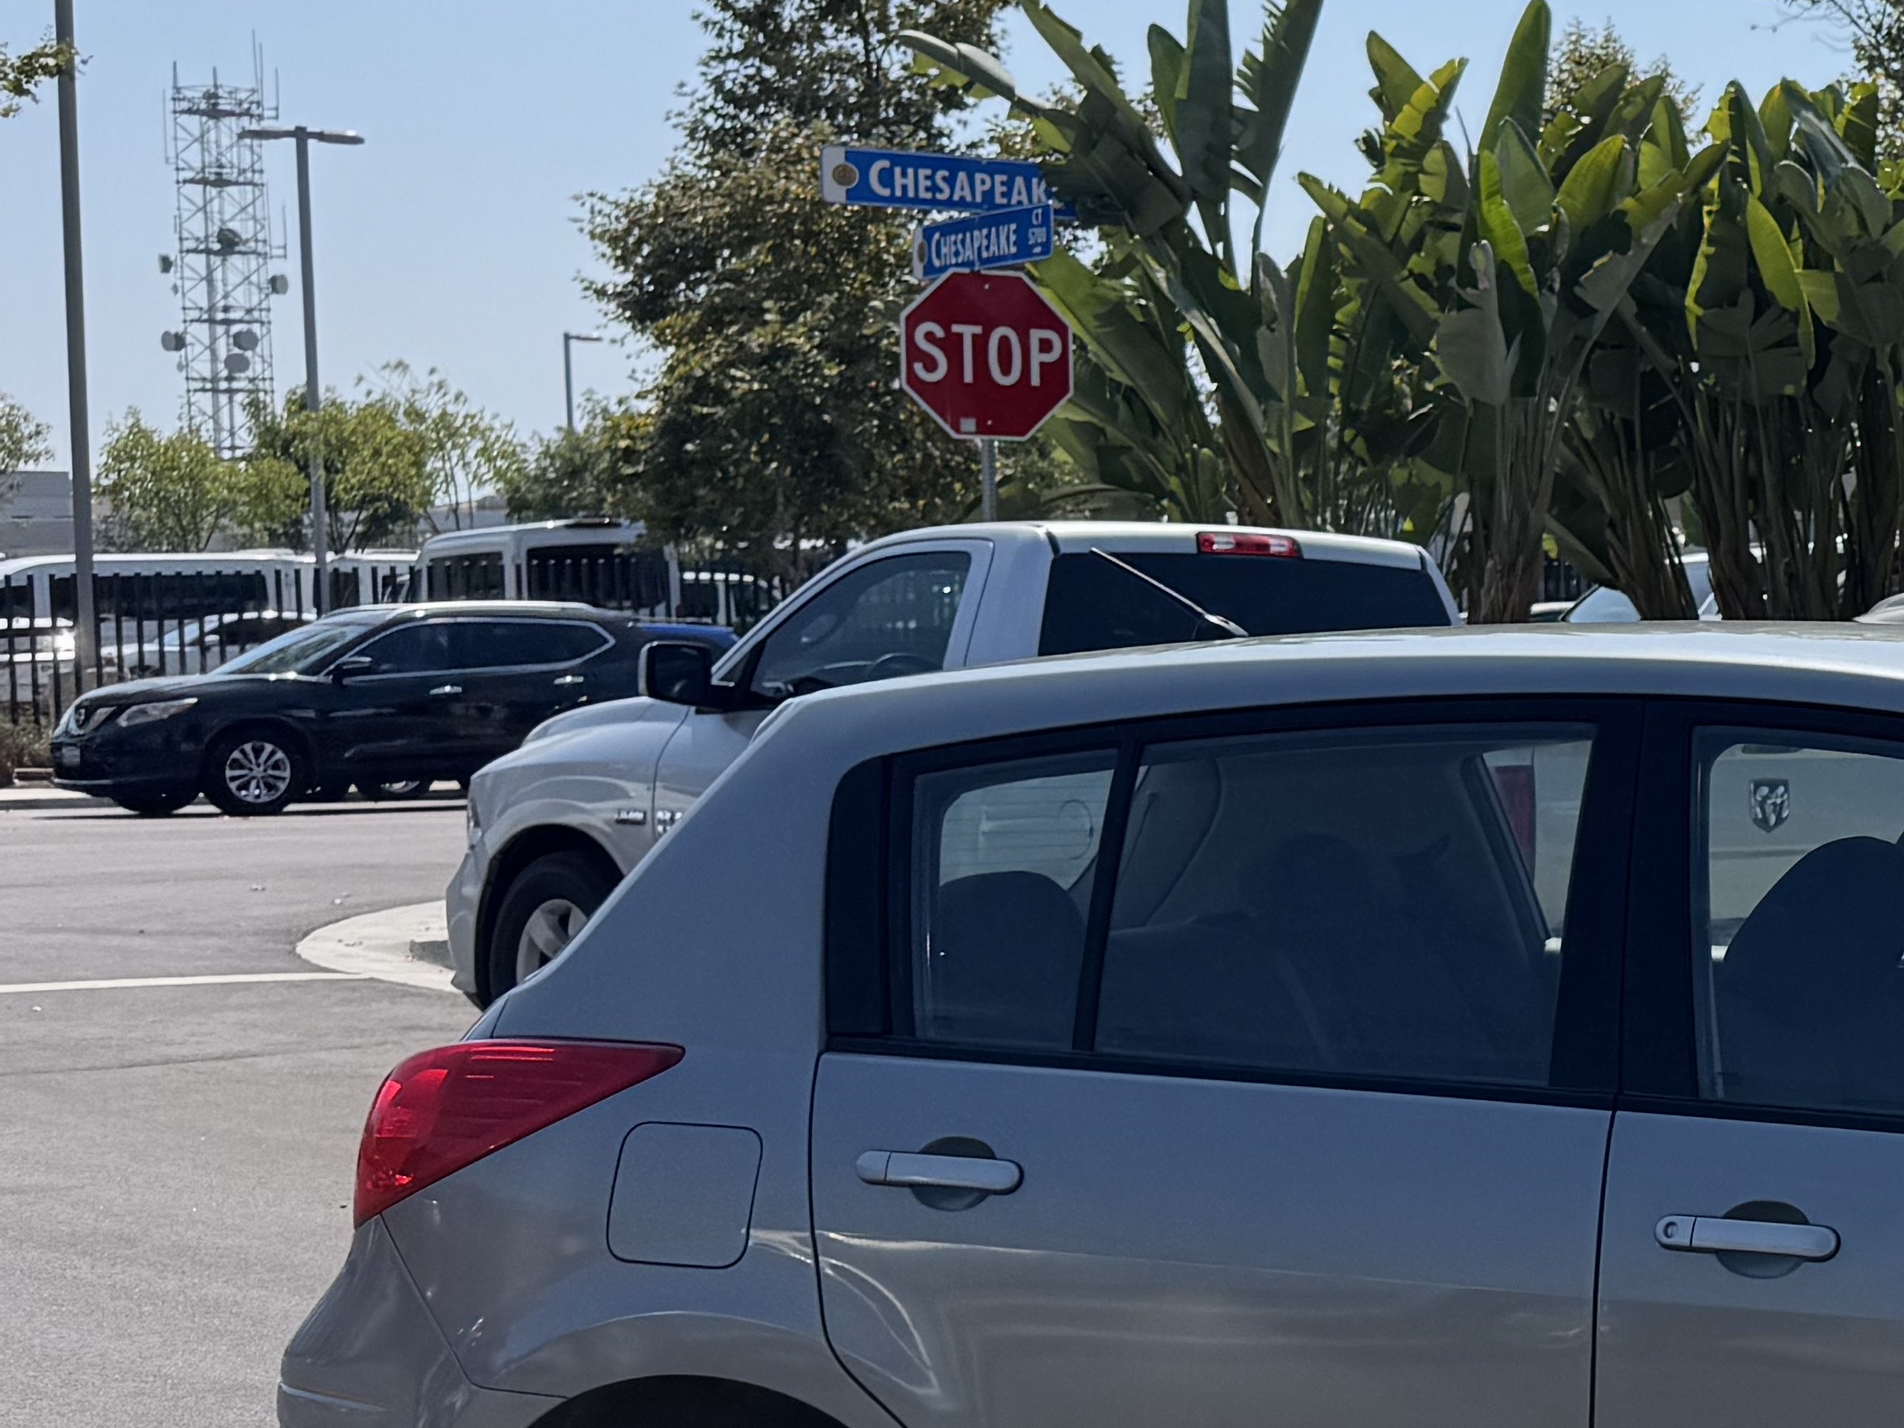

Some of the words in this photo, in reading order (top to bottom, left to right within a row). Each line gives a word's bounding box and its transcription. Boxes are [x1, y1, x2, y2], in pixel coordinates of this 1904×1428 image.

[869, 159, 1056, 206] CHESAPEAK
[931, 224, 1017, 268] CHESAPEAKE
[912, 321, 1063, 387] STOP
